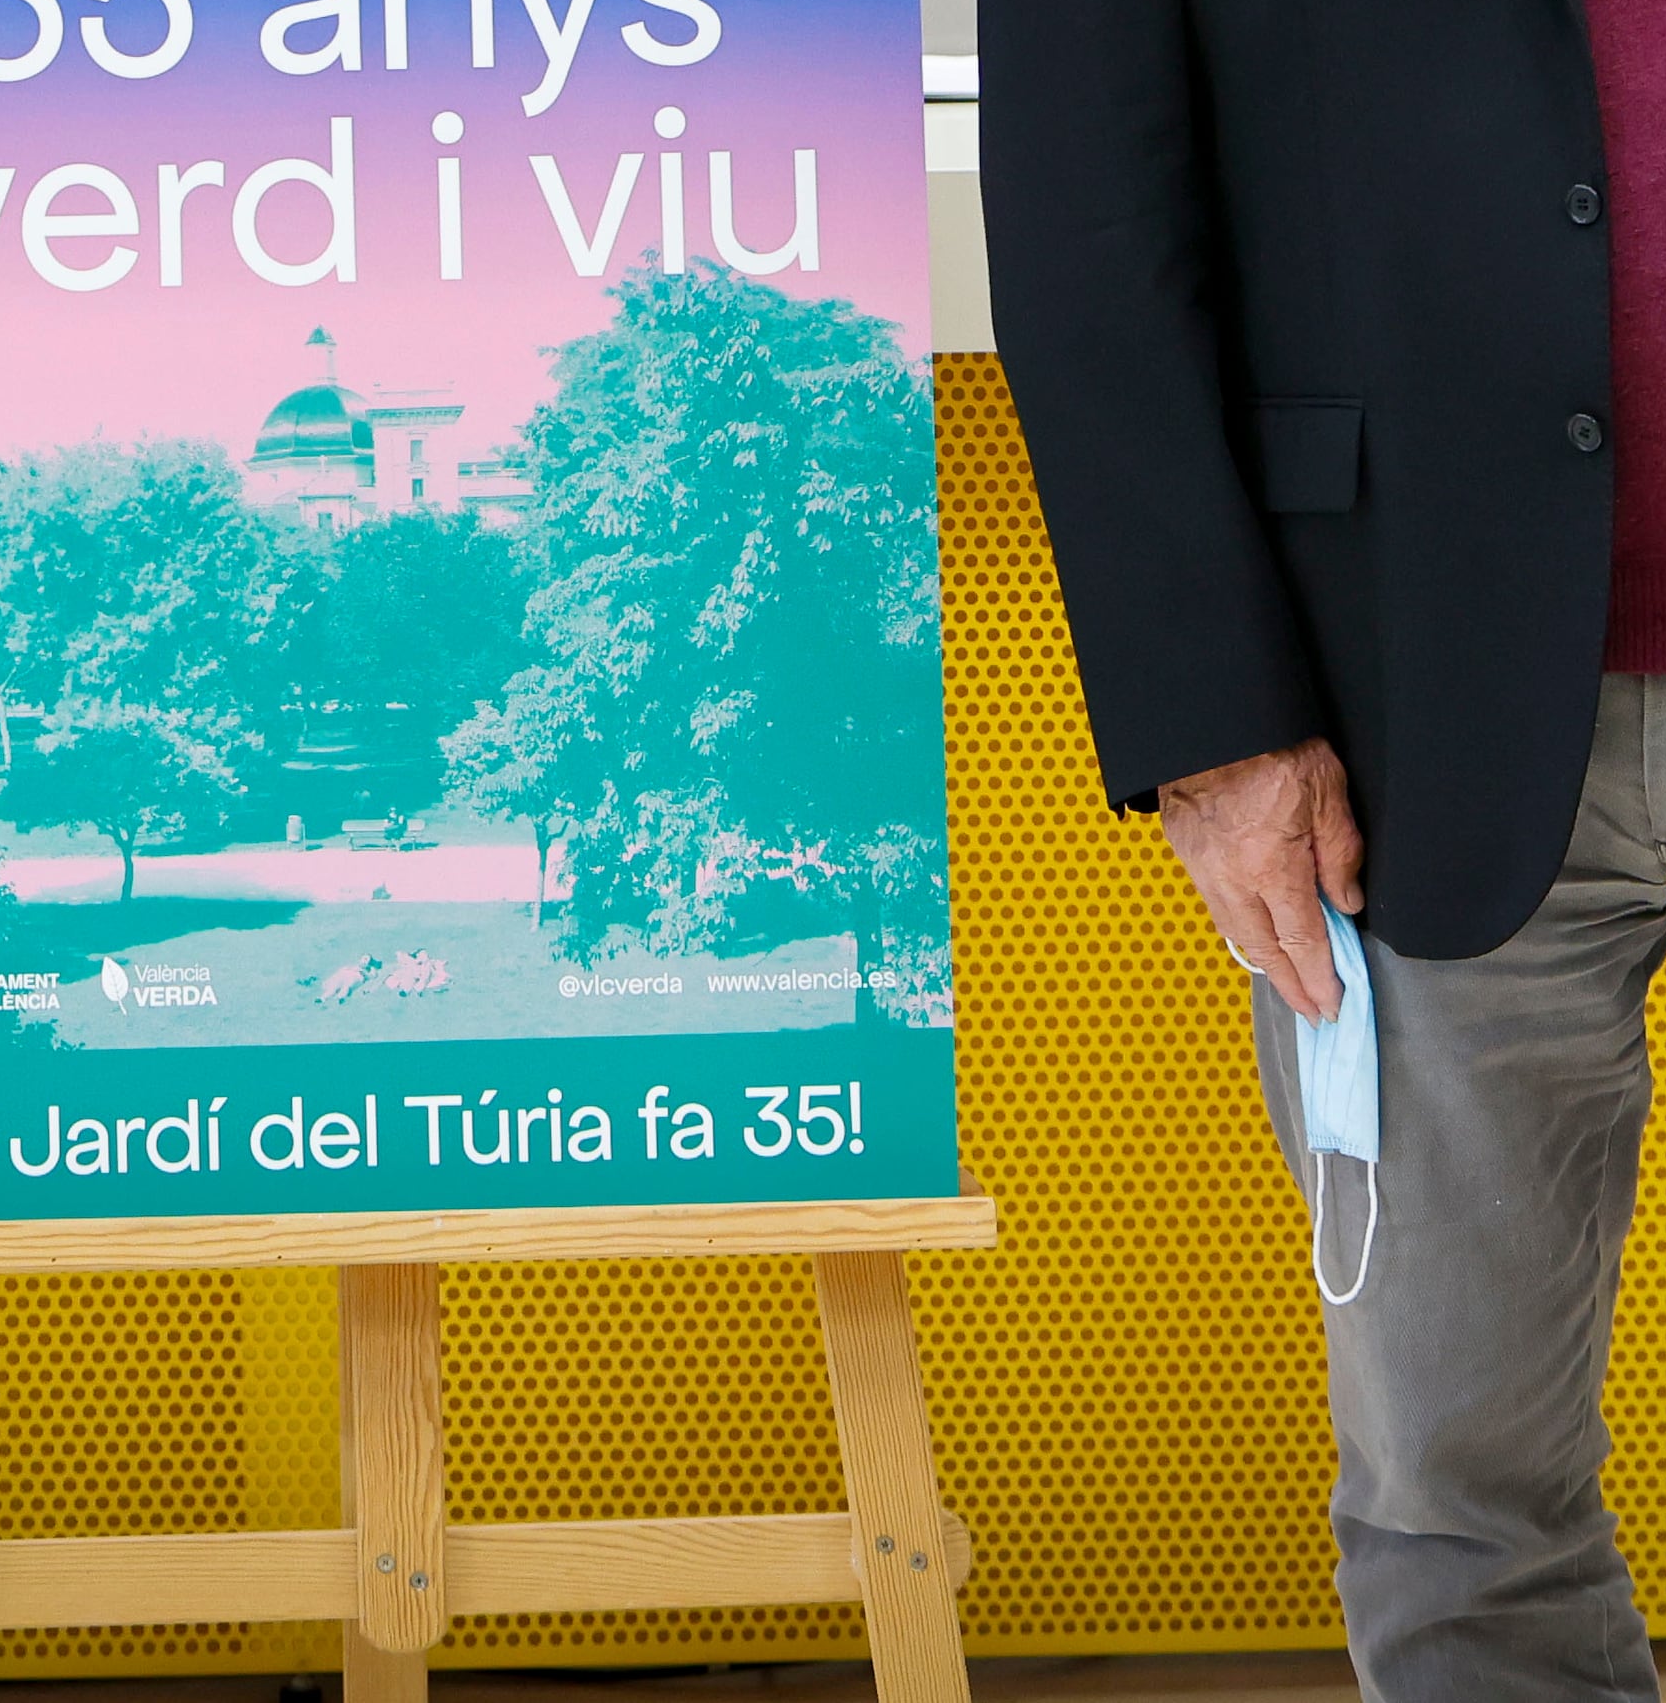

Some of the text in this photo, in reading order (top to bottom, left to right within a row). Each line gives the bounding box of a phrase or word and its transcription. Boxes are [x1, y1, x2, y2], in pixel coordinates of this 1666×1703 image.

[431, 110, 465, 281] i
[527, 105, 821, 278] viu
[133, 963, 211, 983] València
[558, 966, 897, 999] @vlcverda www.valencia.es
[132, 985, 218, 1008] VERDA
[10, 1096, 228, 1177] Jardí
[250, 1094, 378, 1170] del
[404, 1088, 612, 1165] Túria
[638, 1085, 714, 1159] fa
[743, 1081, 864, 1157] 35!
